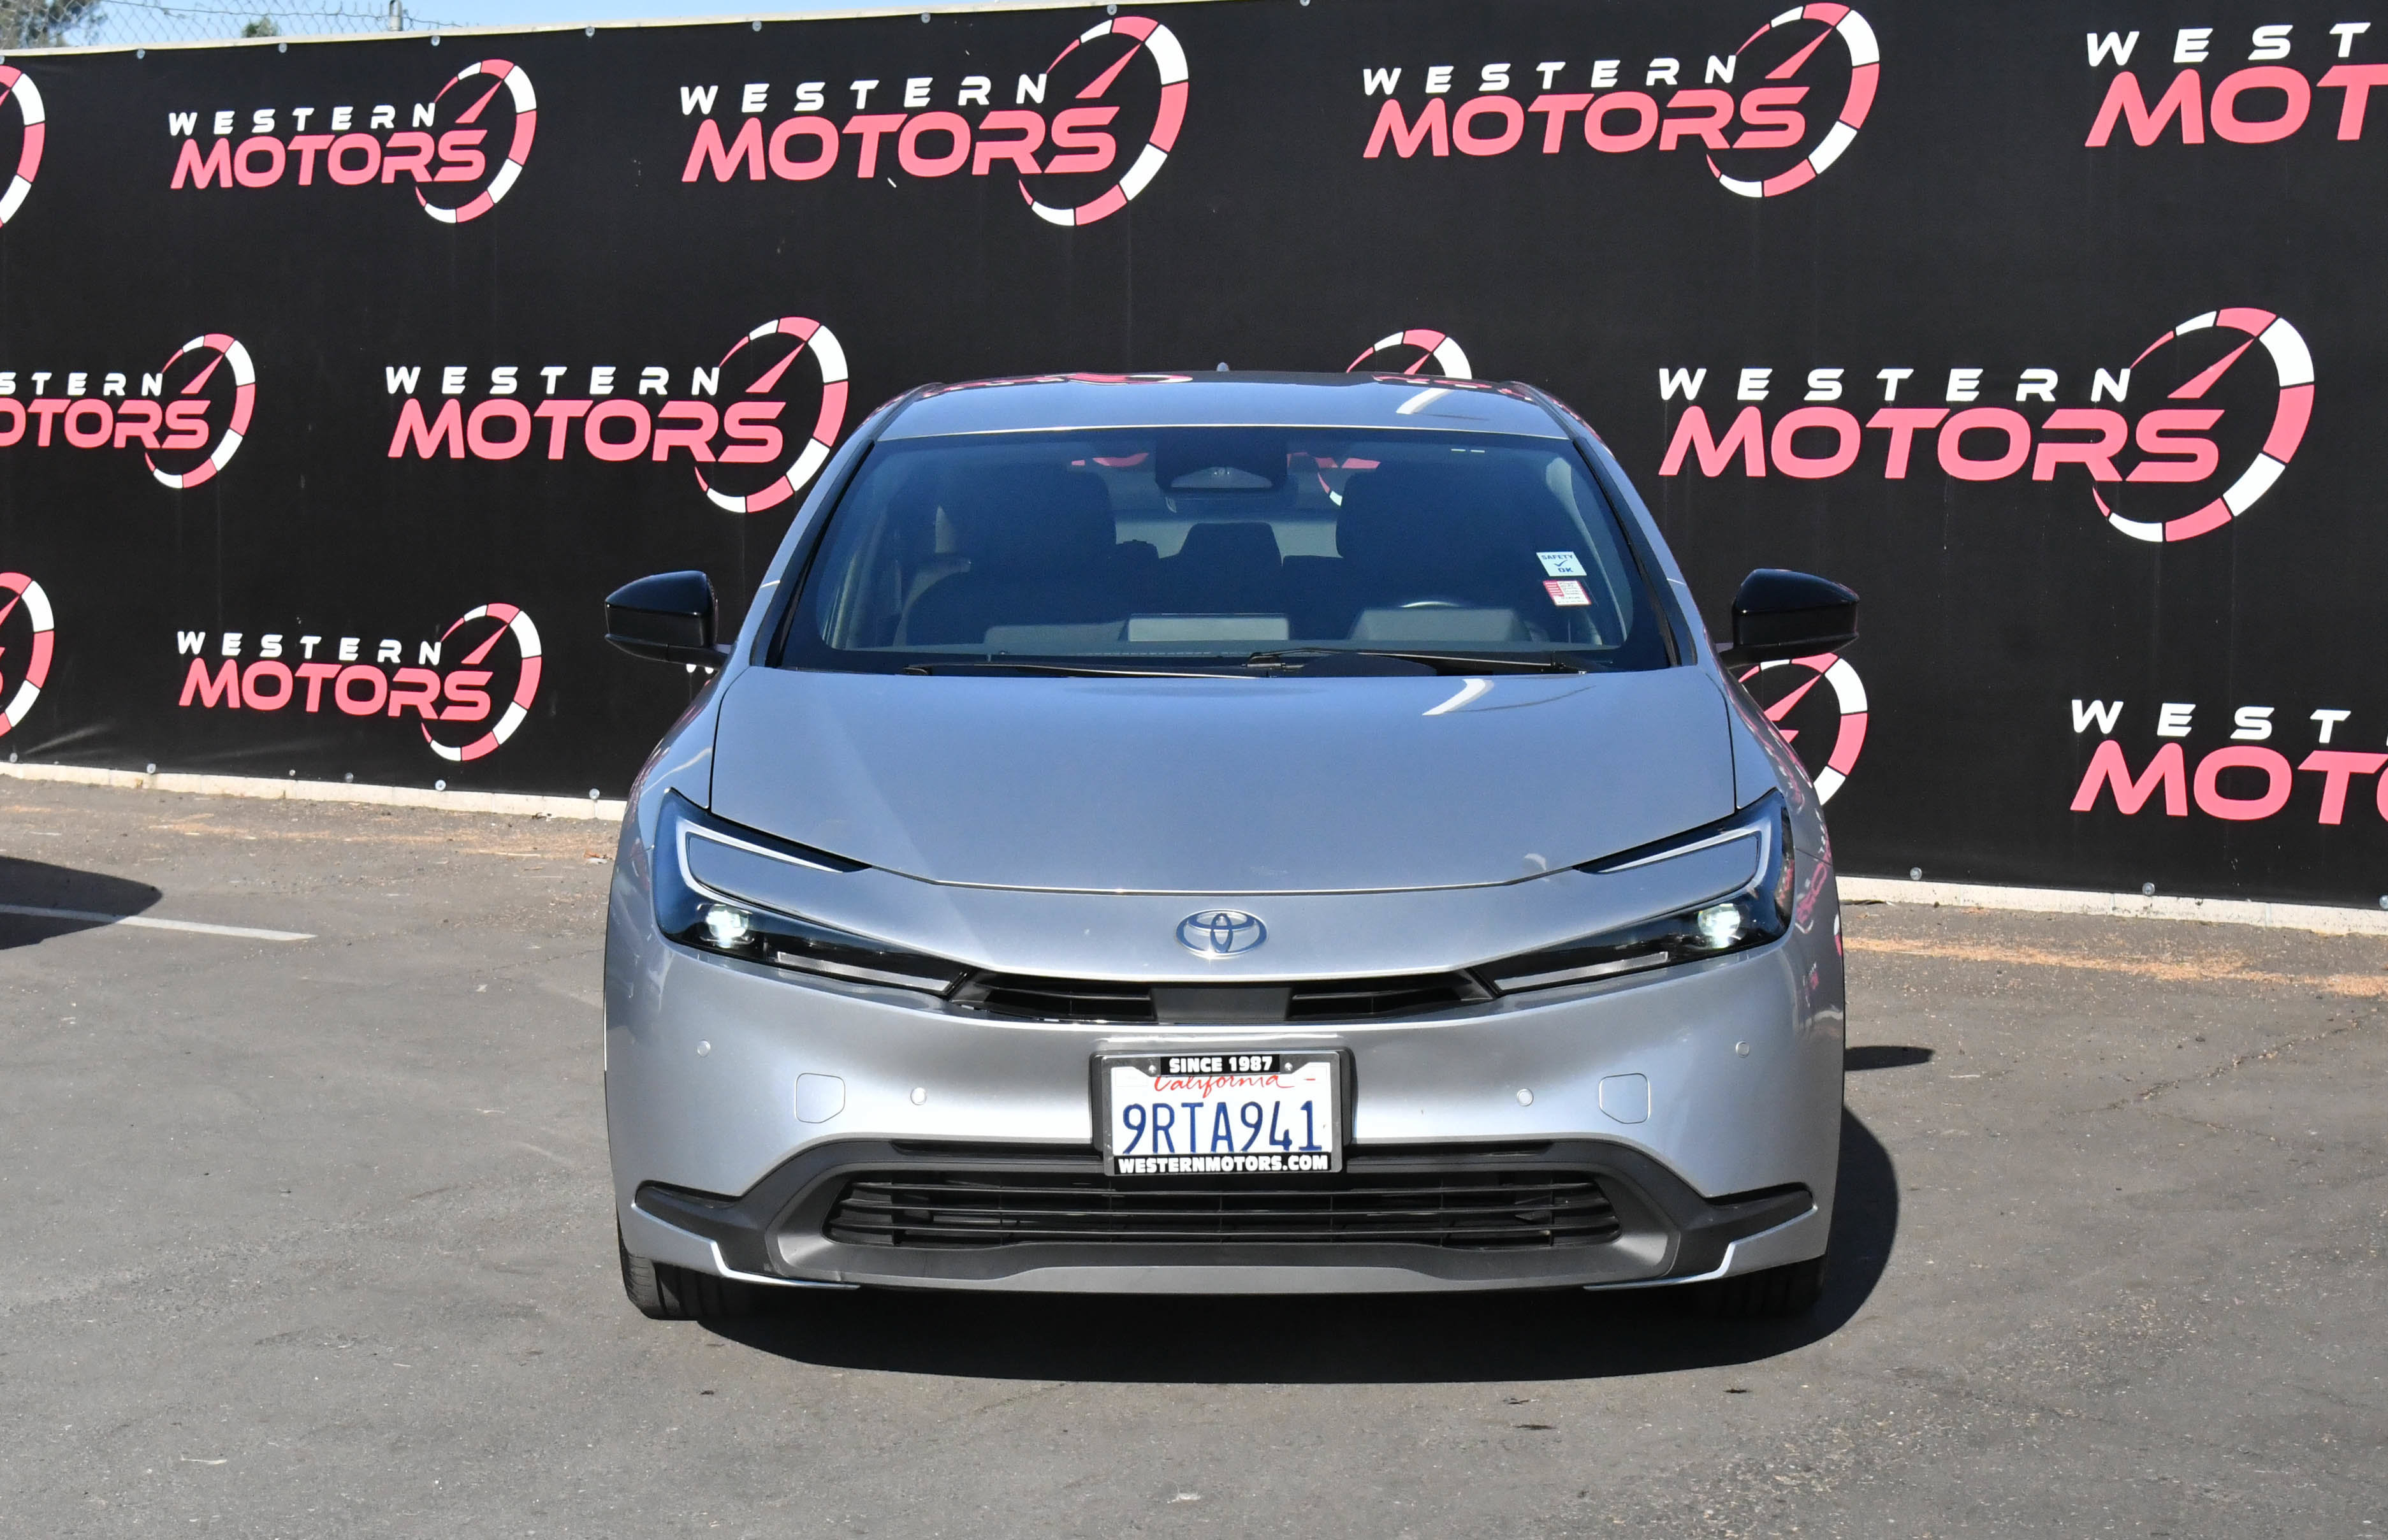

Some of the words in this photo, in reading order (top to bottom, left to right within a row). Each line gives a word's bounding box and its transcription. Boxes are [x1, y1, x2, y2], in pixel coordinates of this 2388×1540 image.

[2086, 22, 2371, 67] WEST
[680, 73, 1047, 115] WESTERN
[1363, 55, 1736, 96] WESTERN
[168, 102, 435, 136] WESTERN
[1363, 86, 1810, 159] MOTORS
[2085, 63, 2388, 147] MOT
[170, 129, 488, 189] MOTORS
[681, 106, 1120, 182] MOTORS
[386, 366, 720, 396] WESTERN
[1659, 367, 2131, 403] WESTERN
[387, 398, 786, 463] MOTORS
[1658, 405, 2225, 483] MOTORS
[177, 631, 442, 665] WESTERN
[178, 657, 493, 722] MOTORS
[2071, 699, 2388, 747] WEST
[2070, 739, 2388, 825] MOT
[1154, 1075, 1295, 1098] California
[1169, 1057, 1223, 1073] SINCE
[1228, 1056, 1273, 1072] 1987
[1122, 1100, 1323, 1154] 9RTA941
[1118, 1154, 1329, 1174] WESTERNMOTORS.COM
